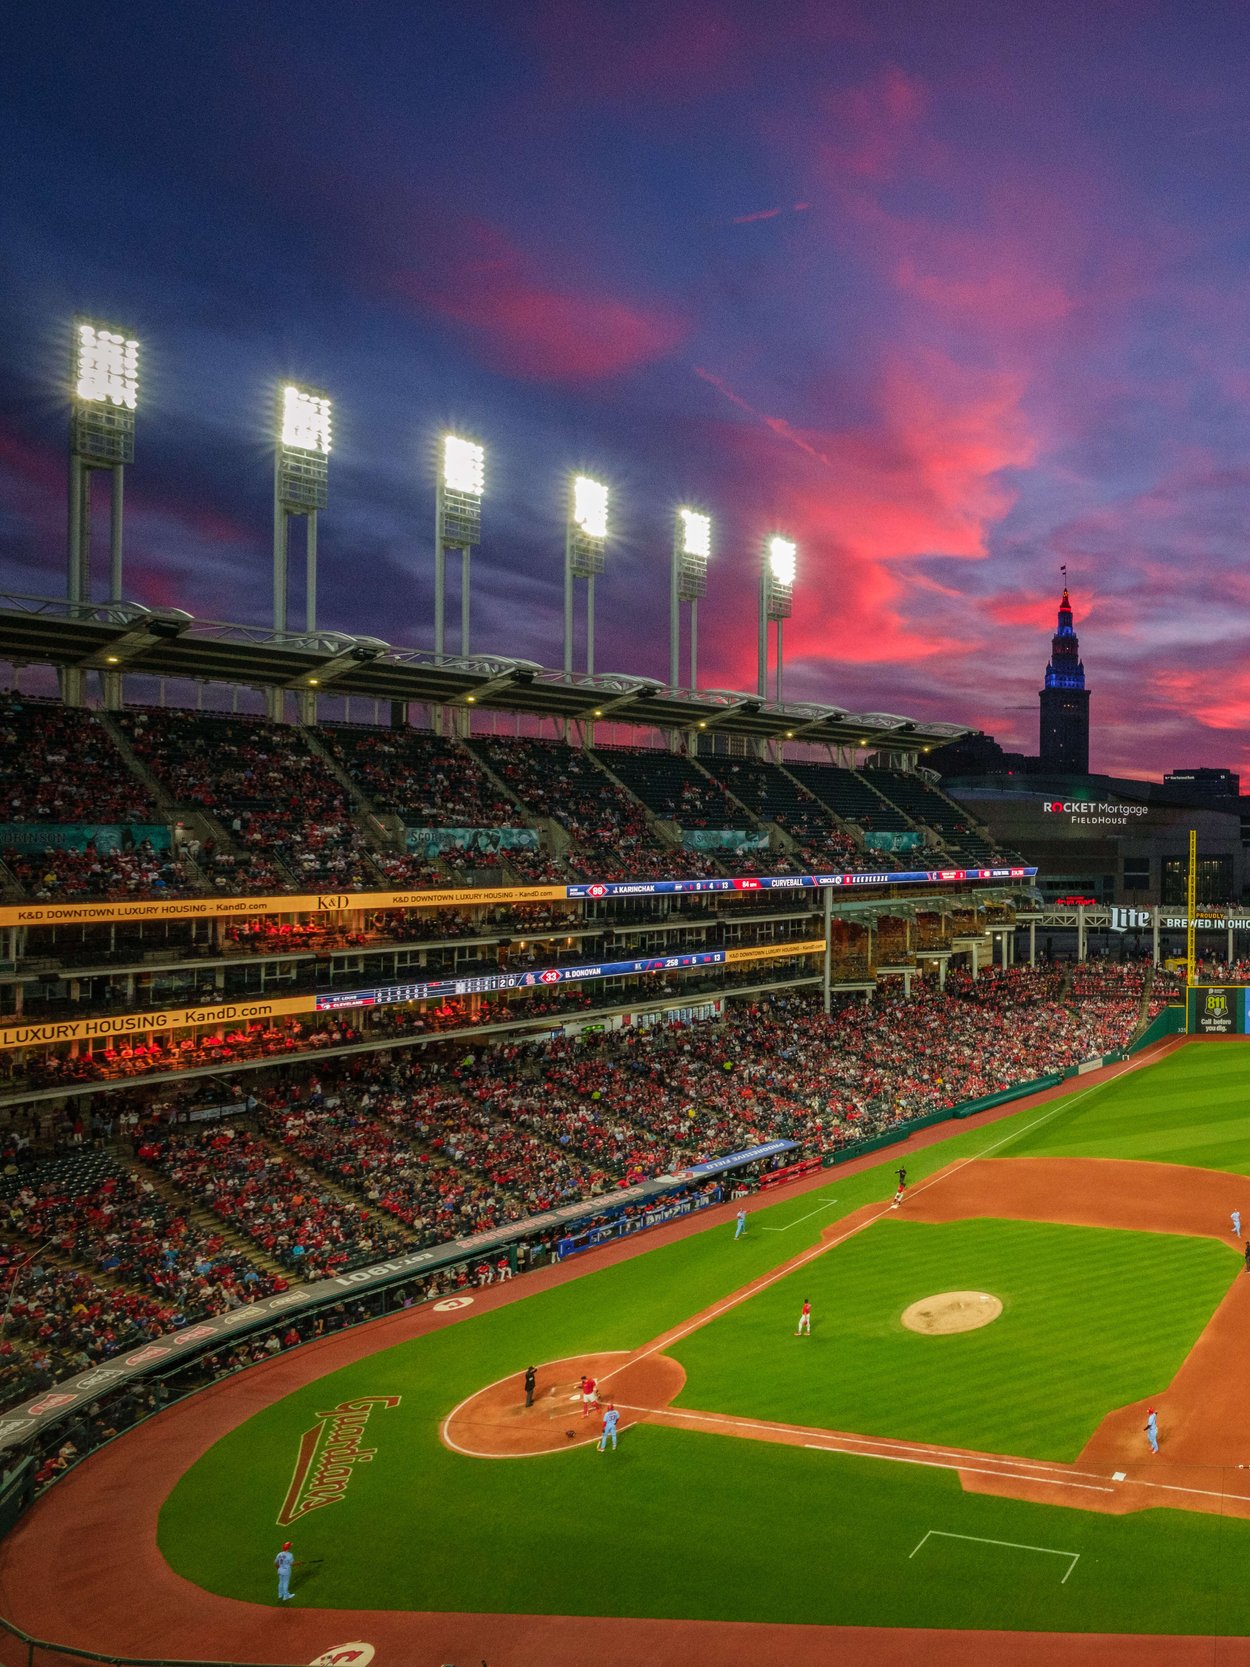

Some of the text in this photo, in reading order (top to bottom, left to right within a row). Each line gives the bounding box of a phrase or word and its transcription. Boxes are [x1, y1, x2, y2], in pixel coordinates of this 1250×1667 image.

[1043, 801, 1149, 816] ROCKET Mortgage
[618, 885, 655, 893] KARINCHAK
[771, 879, 803, 887] CURVEBALL
[317, 895, 349, 910] K&D
[392, 889, 553, 904] K&D DOWNTOWN LUXURY HOUSING KandD.com
[18, 902, 267, 920] K&D DOWNTOWN LUXURY HOUSING KandD.com
[1110, 907, 1150, 933] Lite
[1166, 918, 1212, 929] BREWED
[1214, 919, 1225, 929] IN
[546, 973, 557, 981] 33
[571, 968, 601, 977] DONOVAN
[1207, 996, 1225, 1009] 811
[3, 1003, 272, 1045] LUXURY HOUSING KandD.com
[335, 1262, 402, 1286] 1901
[276, 1395, 402, 1527] Guardians
